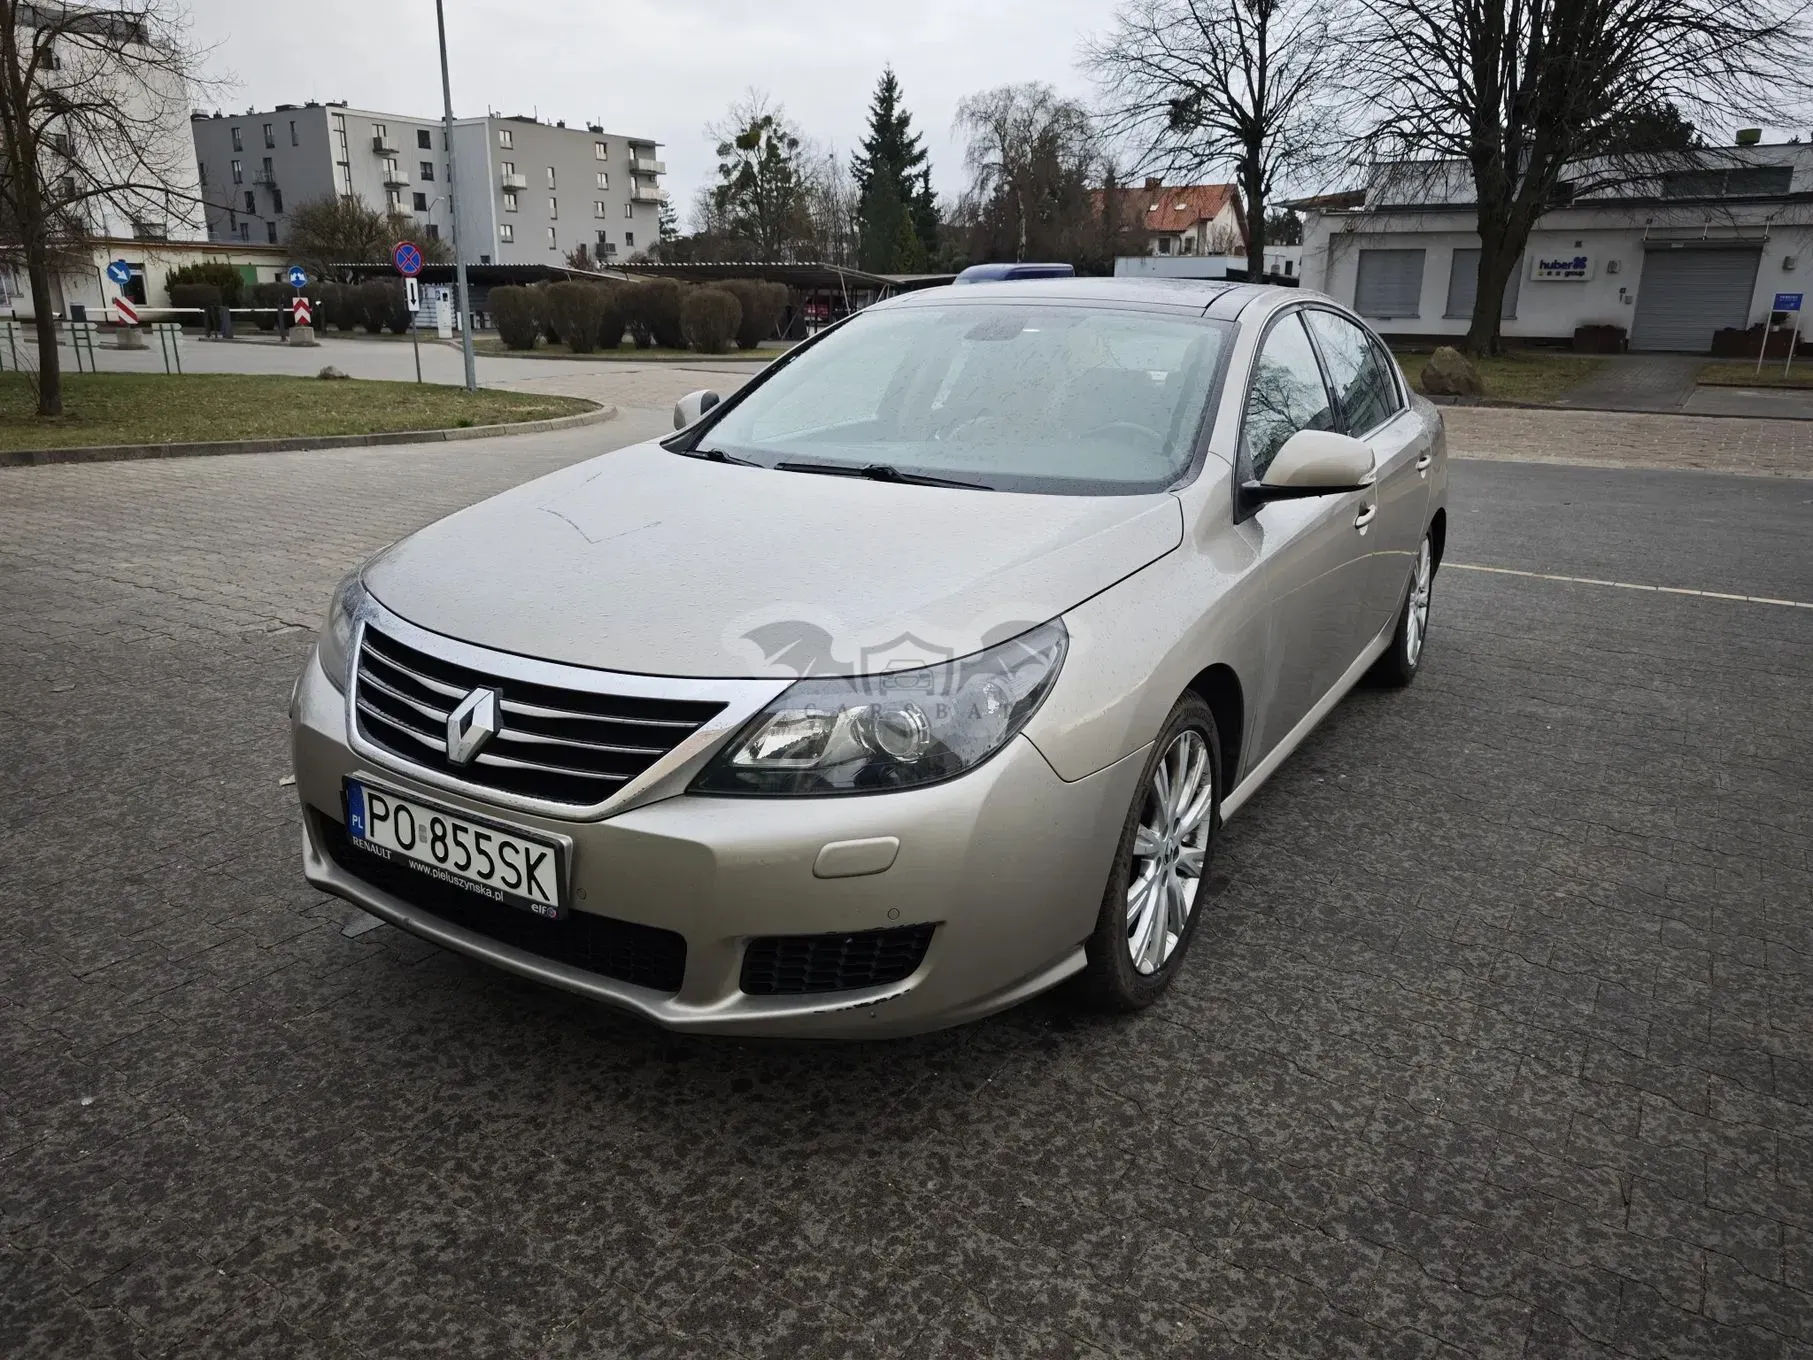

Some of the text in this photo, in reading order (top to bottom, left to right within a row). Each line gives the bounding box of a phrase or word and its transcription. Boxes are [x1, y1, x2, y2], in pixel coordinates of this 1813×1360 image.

[1540, 260, 1573, 270] huber
[352, 814, 363, 829] PL
[352, 836, 392, 859] RENAULT
[367, 792, 551, 902] PO 855SK
[531, 903, 547, 915] elf
